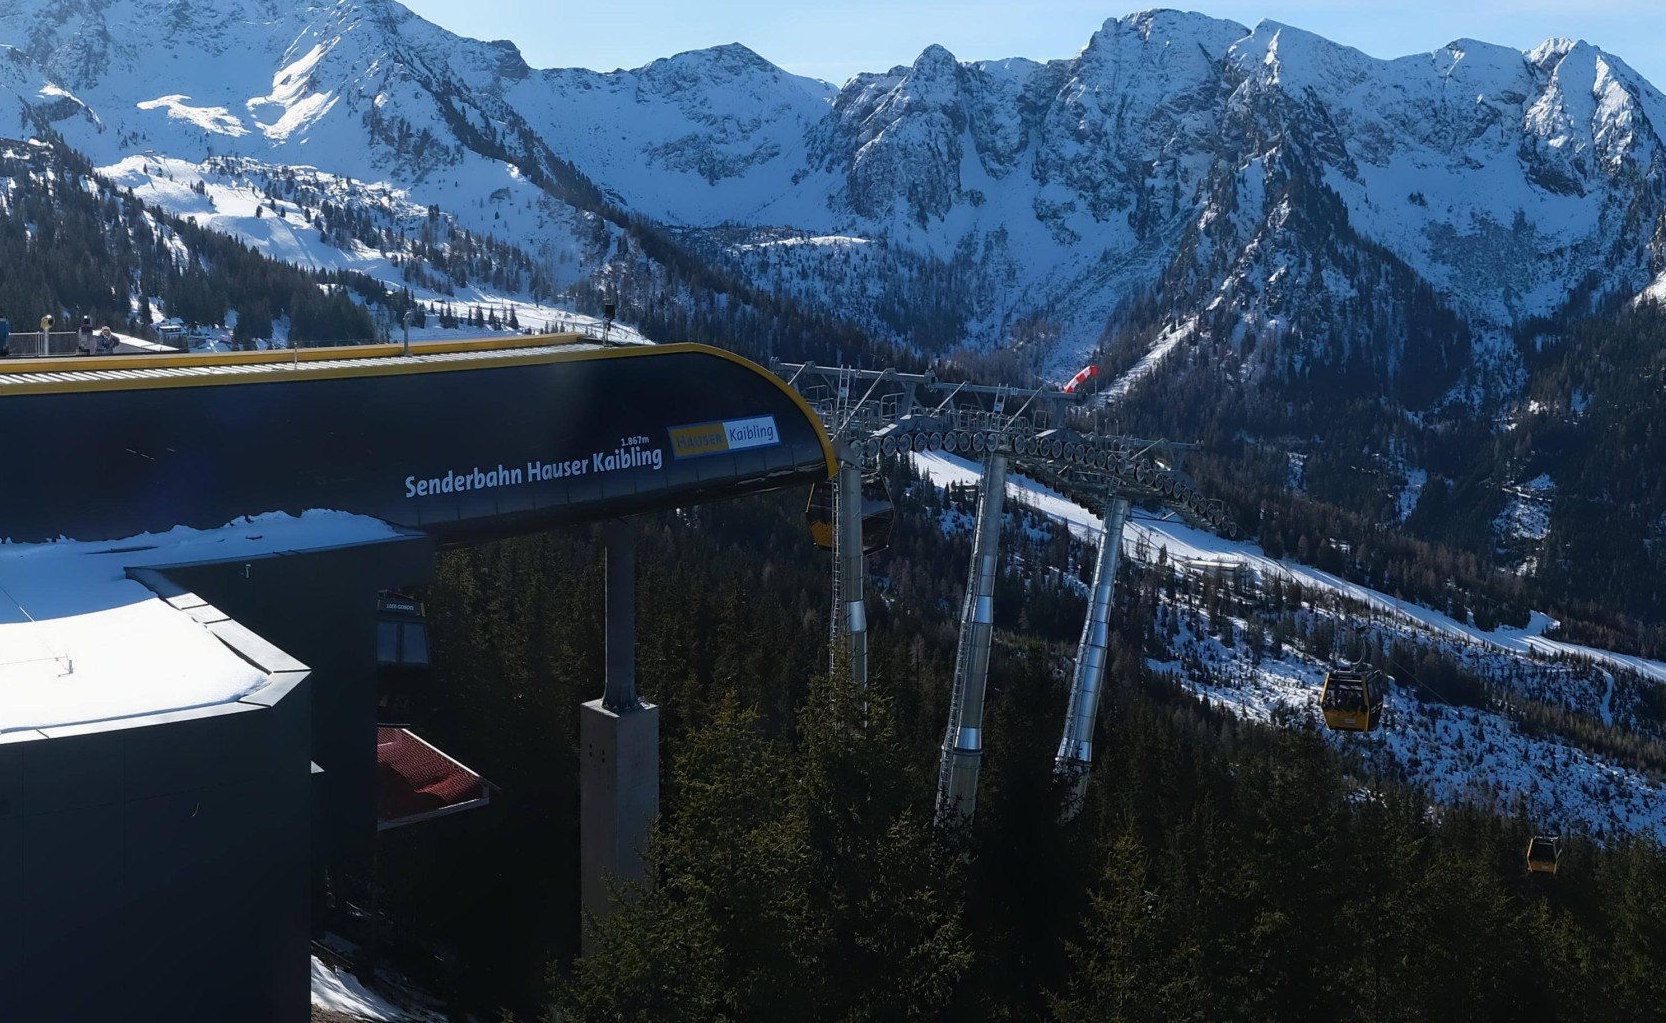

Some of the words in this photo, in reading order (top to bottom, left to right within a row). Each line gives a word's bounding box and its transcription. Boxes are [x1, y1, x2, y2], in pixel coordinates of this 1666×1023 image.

[620, 435, 650, 447] 1.867m
[676, 433, 722, 450] HAUSER
[729, 425, 774, 443] Kaibling
[405, 464, 523, 498] Senderbahn
[527, 456, 589, 482] Hauser
[592, 445, 663, 472] Kaibling
